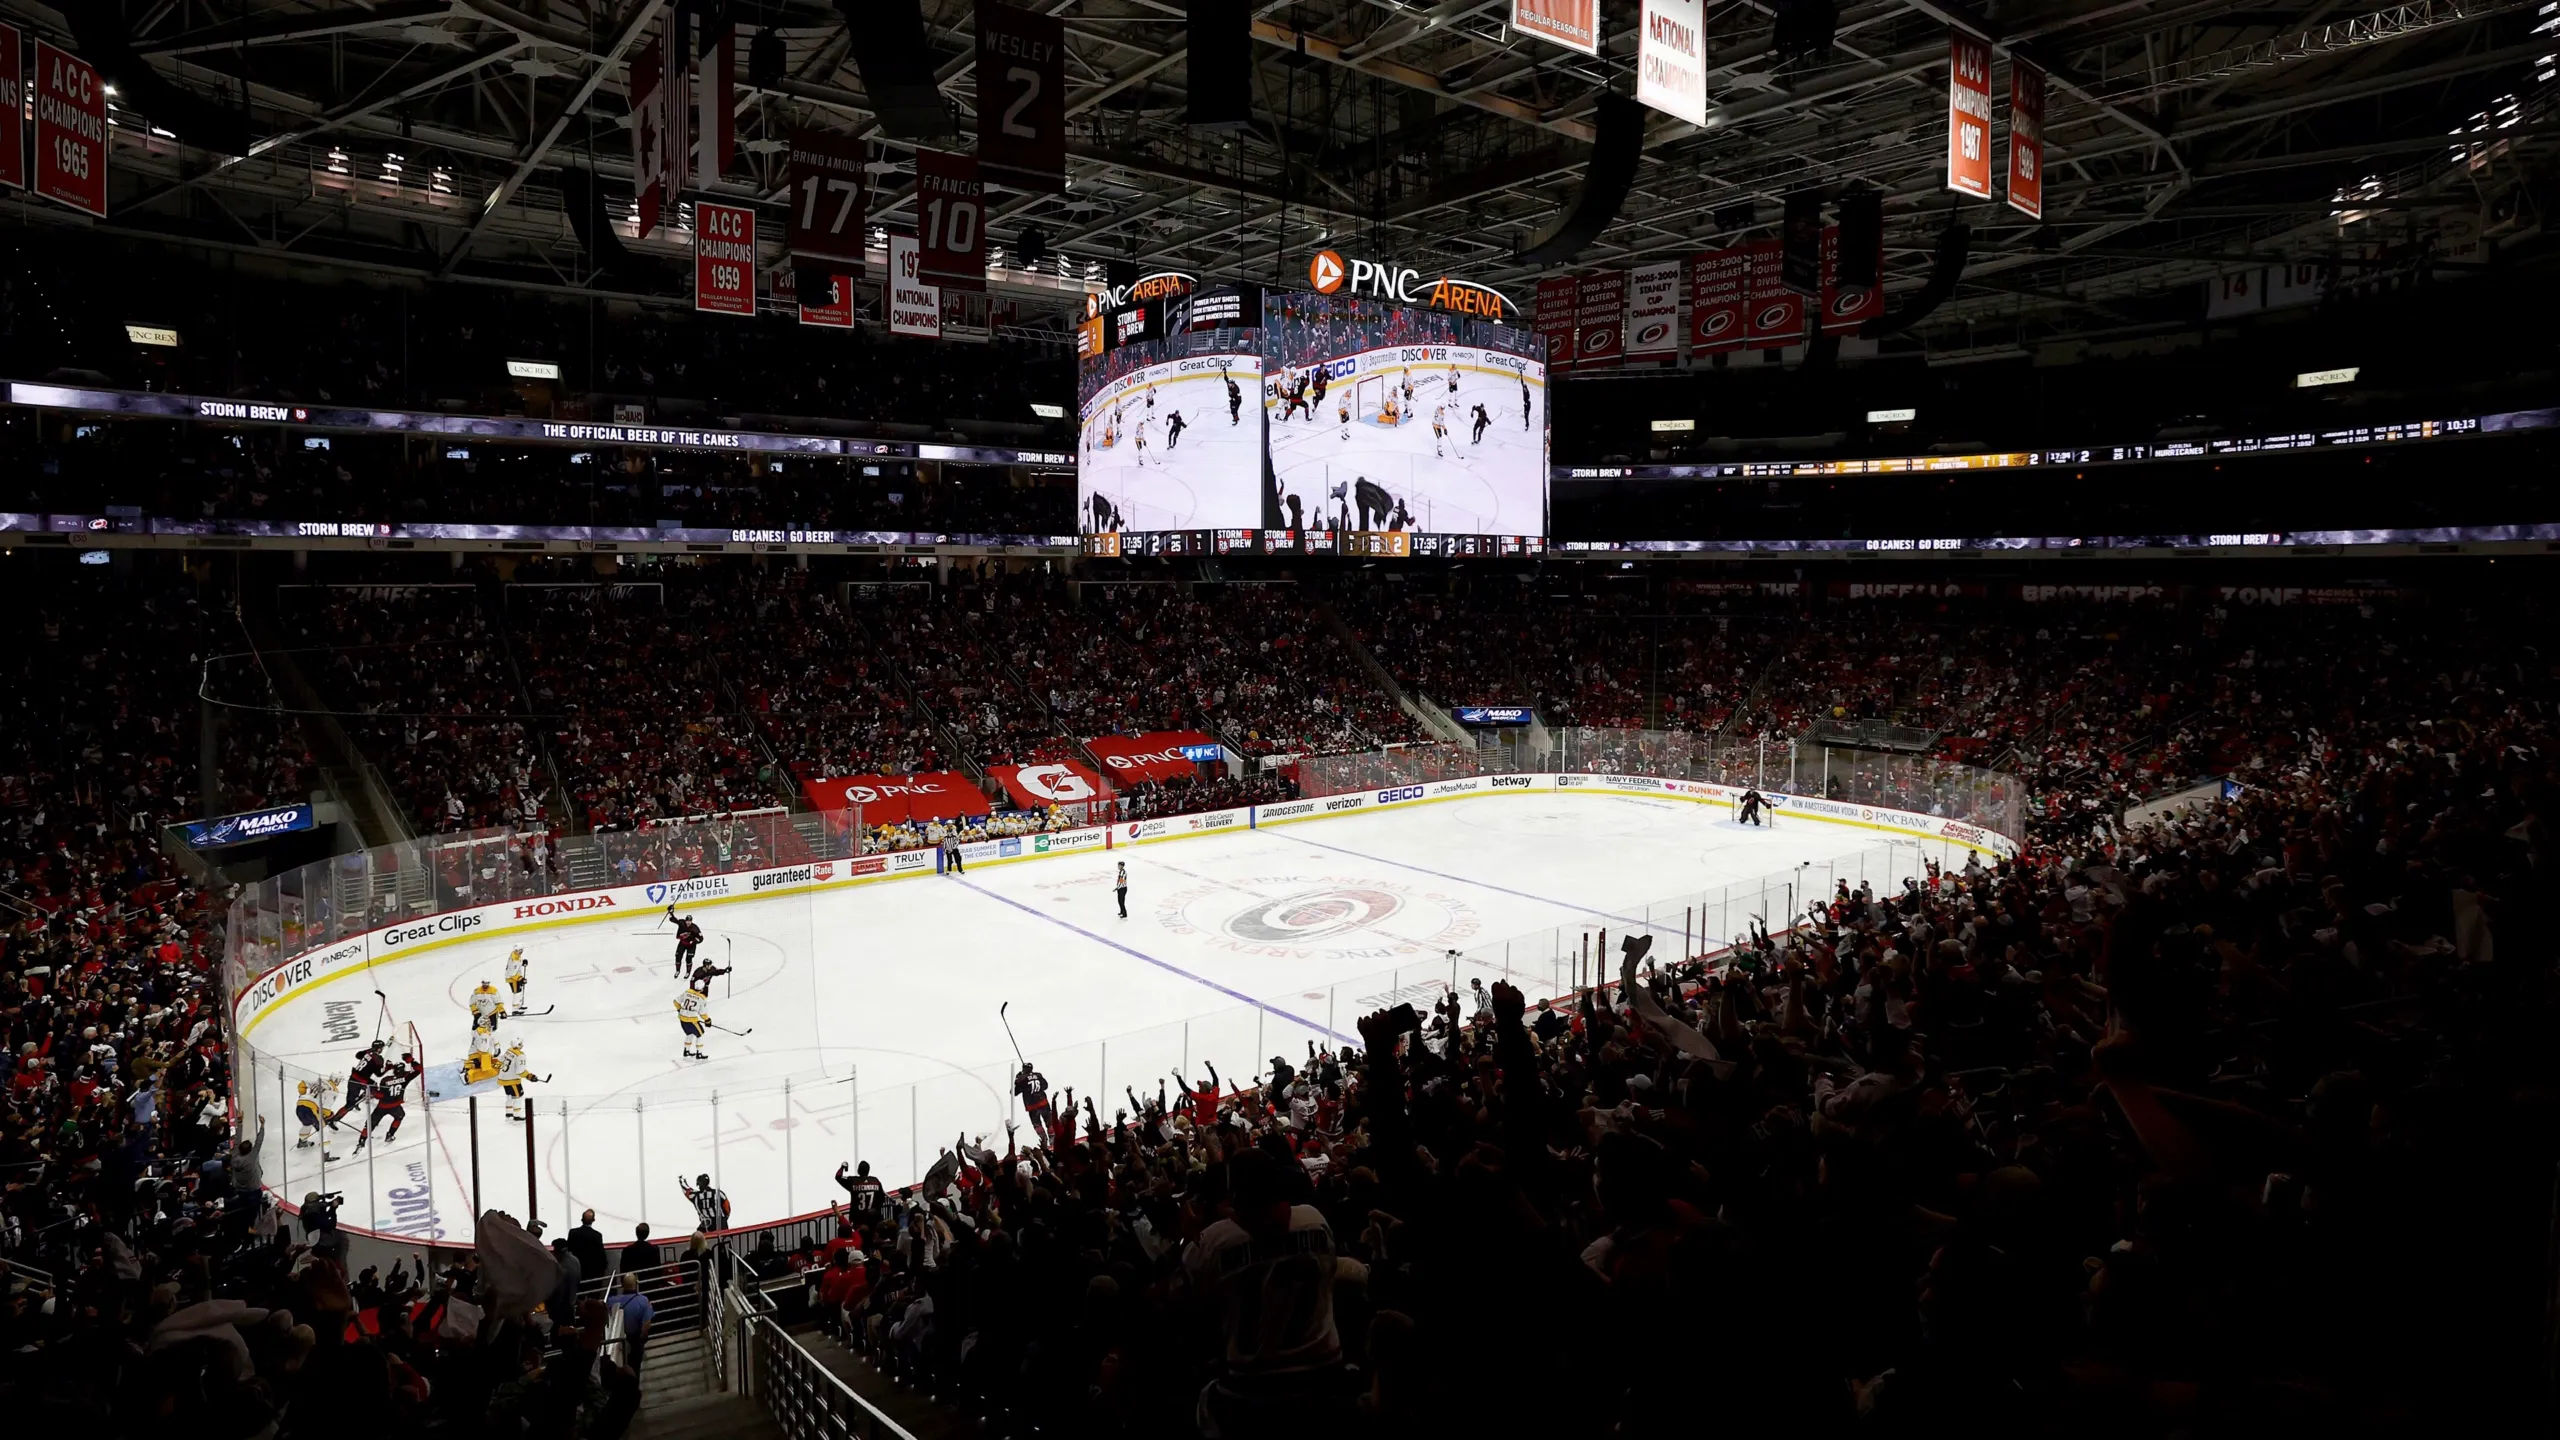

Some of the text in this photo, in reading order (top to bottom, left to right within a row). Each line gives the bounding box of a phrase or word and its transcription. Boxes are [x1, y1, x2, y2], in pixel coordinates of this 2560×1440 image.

[1520, 9, 1552, 27] REGULAR
[1552, 19, 1579, 38] SEASON
[1650, 11, 1696, 58] NATIONAL
[984, 29, 1055, 64] WESLEY
[1960, 42, 1983, 83] ACC
[52, 57, 91, 105] ACC
[1002, 67, 1041, 139] 2
[40, 93, 103, 143] CHAMPIONS
[54, 135, 90, 180] 1965
[793, 150, 863, 173] BRIND'AMOUR
[923, 174, 981, 197] FRANCIS
[802, 174, 859, 235] 17
[709, 210, 742, 238] ACC
[927, 197, 976, 253] 10
[700, 238, 752, 263] CHAMPIONS
[1696, 256, 1743, 272] 2005-2006
[711, 266, 741, 291] 1959
[1350, 259, 1420, 302] PNC
[1635, 270, 1679, 284] 2005-2006
[1695, 267, 1742, 284] SOUTHEAST
[1132, 275, 1181, 302] ARENA
[1582, 280, 1622, 293] 2005-2006
[1640, 282, 1672, 294] STANLEY
[1700, 281, 1736, 295] DIVISION
[896, 288, 934, 307] NATIONAL
[1098, 285, 1126, 310] PNC
[1210, 295, 1239, 304] PLAY SHOTS
[1431, 276, 1503, 319] ARENA
[1586, 291, 1616, 303] EASTERN
[1647, 295, 1663, 305] CUP
[1695, 292, 1740, 307] CHAMPIONS
[1223, 303, 1239, 311] SHOTS
[1543, 299, 1568, 309] EASTERN
[1581, 302, 1620, 315] CONFERENCE
[1117, 310, 1138, 326] STORM
[1223, 310, 1240, 319] SHOTS
[1538, 310, 1573, 321] CONFERENCE
[1632, 305, 1676, 318] CHAMPIONS
[893, 309, 938, 328] CHAMPIONS
[1581, 313, 1620, 326] CHAMPIONS
[1127, 321, 1145, 336] BREW
[1537, 320, 1571, 331] CHAMPIONS
[130, 330, 176, 343] UNC REX
[1402, 349, 1447, 362] DISCOVER
[1485, 353, 1527, 371] Great Clips
[1179, 357, 1232, 371] Great Clips
[535, 367, 552, 375] REX
[2309, 372, 2348, 383] UNC REX
[1114, 372, 1145, 394] DISCOVER
[200, 402, 288, 420] STORM BREW
[2447, 418, 2476, 430] 10:13
[543, 424, 739, 447] THE OFFICIAL BEER OF THE CANES
[1017, 452, 1065, 464] STORM BREW
[2080, 451, 2089, 462] 2
[2154, 446, 2204, 457] HURRICANES
[2030, 453, 2038, 464] 2
[1572, 467, 1621, 477] STORM BREW
[1930, 461, 1968, 470] PREDATORS
[299, 522, 374, 537] STORM BREW
[732, 529, 834, 543] GO CANES! GO BEER!
[1217, 530, 1243, 539] STORM
[1264, 530, 1286, 539] STORM
[1305, 531, 1326, 540] STORM
[1049, 536, 1072, 546] STORM
[1108, 537, 1115, 553] 2
[1122, 536, 1142, 549] 17:35
[1152, 535, 1160, 552] 2
[1197, 542, 1202, 550] 1
[1229, 538, 1252, 548] BREW
[1275, 539, 1294, 548] BREW
[1315, 539, 1333, 549] BREW
[1393, 537, 1402, 552] 2
[1414, 537, 1437, 550] 17:35
[1447, 537, 1455, 552] 2
[1501, 536, 1515, 544] STORM
[1566, 541, 1611, 550] STORM BREW
[1866, 538, 1961, 550] GO CANES! GO BEER!
[2209, 533, 2269, 546] STORM BREW
[1171, 541, 1180, 552] 25
[1370, 541, 1380, 552] 16
[1465, 543, 1475, 553] 25
[1508, 544, 1519, 552] BREW
[1532, 544, 1542, 552] BREW
[1487, 709, 1521, 717] MAKO
[1133, 747, 1182, 766] PNC
[1204, 748, 1214, 756] NC
[1440, 781, 1477, 793] MassMutual
[1492, 776, 1532, 788] betway
[1629, 777, 1661, 786] FEDERAL
[877, 781, 944, 797] PNC
[1377, 786, 1424, 803] GEICO
[1326, 797, 1362, 810] verizon
[1792, 798, 1802, 808] NEW
[1803, 800, 1839, 814] AMSTERDAM
[1840, 806, 1858, 817] VODKA
[1262, 803, 1314, 818] BRIDGESTONE
[238, 810, 298, 831] MAKO
[1141, 821, 1165, 833] pepsi
[1205, 818, 1233, 828] DELIVERY
[245, 823, 289, 836] MEDICAL
[1039, 831, 1101, 847] enterprise
[973, 845, 997, 853] SUMMER
[974, 850, 997, 858] COOLER
[895, 852, 926, 864] TRULY
[813, 864, 833, 876] Rate
[752, 865, 811, 890] guaranteed
[670, 878, 729, 894] FANDUEL
[670, 886, 730, 901] SPORTSBOOK
[513, 895, 616, 919] HONDA
[384, 914, 482, 946] Great Clips
[252, 959, 313, 1011] DISCOVER
[321, 999, 362, 1045] betway
[857, 1192, 874, 1212] 37
